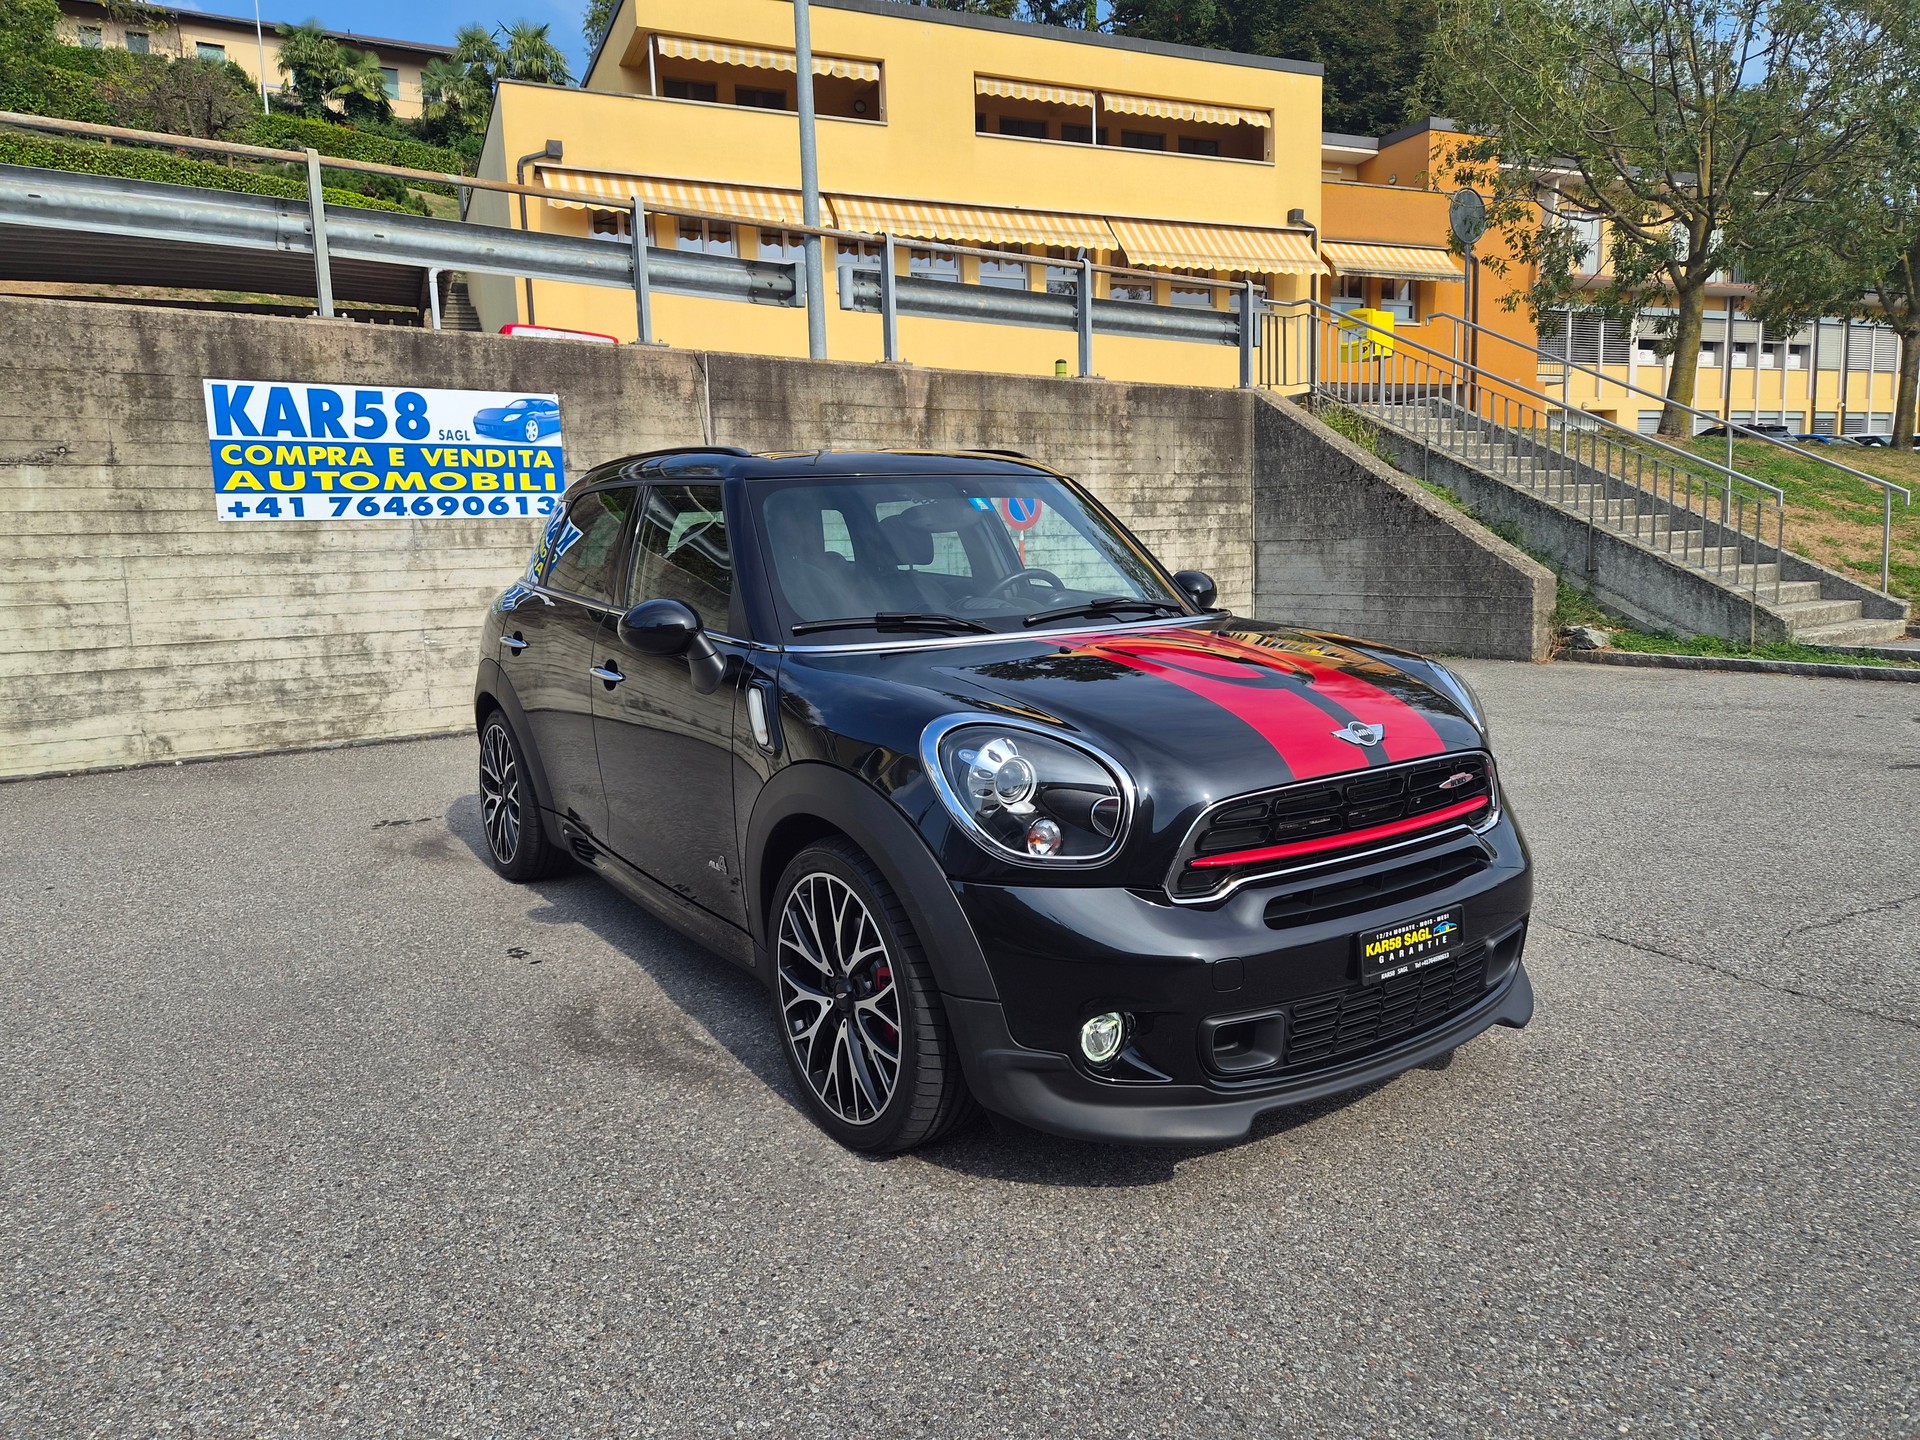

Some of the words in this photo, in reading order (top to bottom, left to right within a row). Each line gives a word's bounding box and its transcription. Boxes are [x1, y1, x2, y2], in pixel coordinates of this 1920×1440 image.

[211, 384, 431, 441] KAR58
[438, 429, 471, 442] SAGL
[220, 444, 374, 467] COMPRA
[389, 447, 405, 467] E
[420, 447, 555, 469] VENDITA
[223, 470, 556, 492] AUTOMOBILI
[227, 496, 306, 518] +41
[329, 496, 555, 518] 764690613
[1354, 728, 1373, 738] MINI
[1376, 930, 1393, 940] 12/24
[1393, 924, 1416, 935] MONATE
[1419, 918, 1433, 928] MOIS
[1365, 936, 1402, 957] KAR58
[1404, 927, 1432, 946] SAGL
[1378, 935, 1448, 964] GARANTIE
